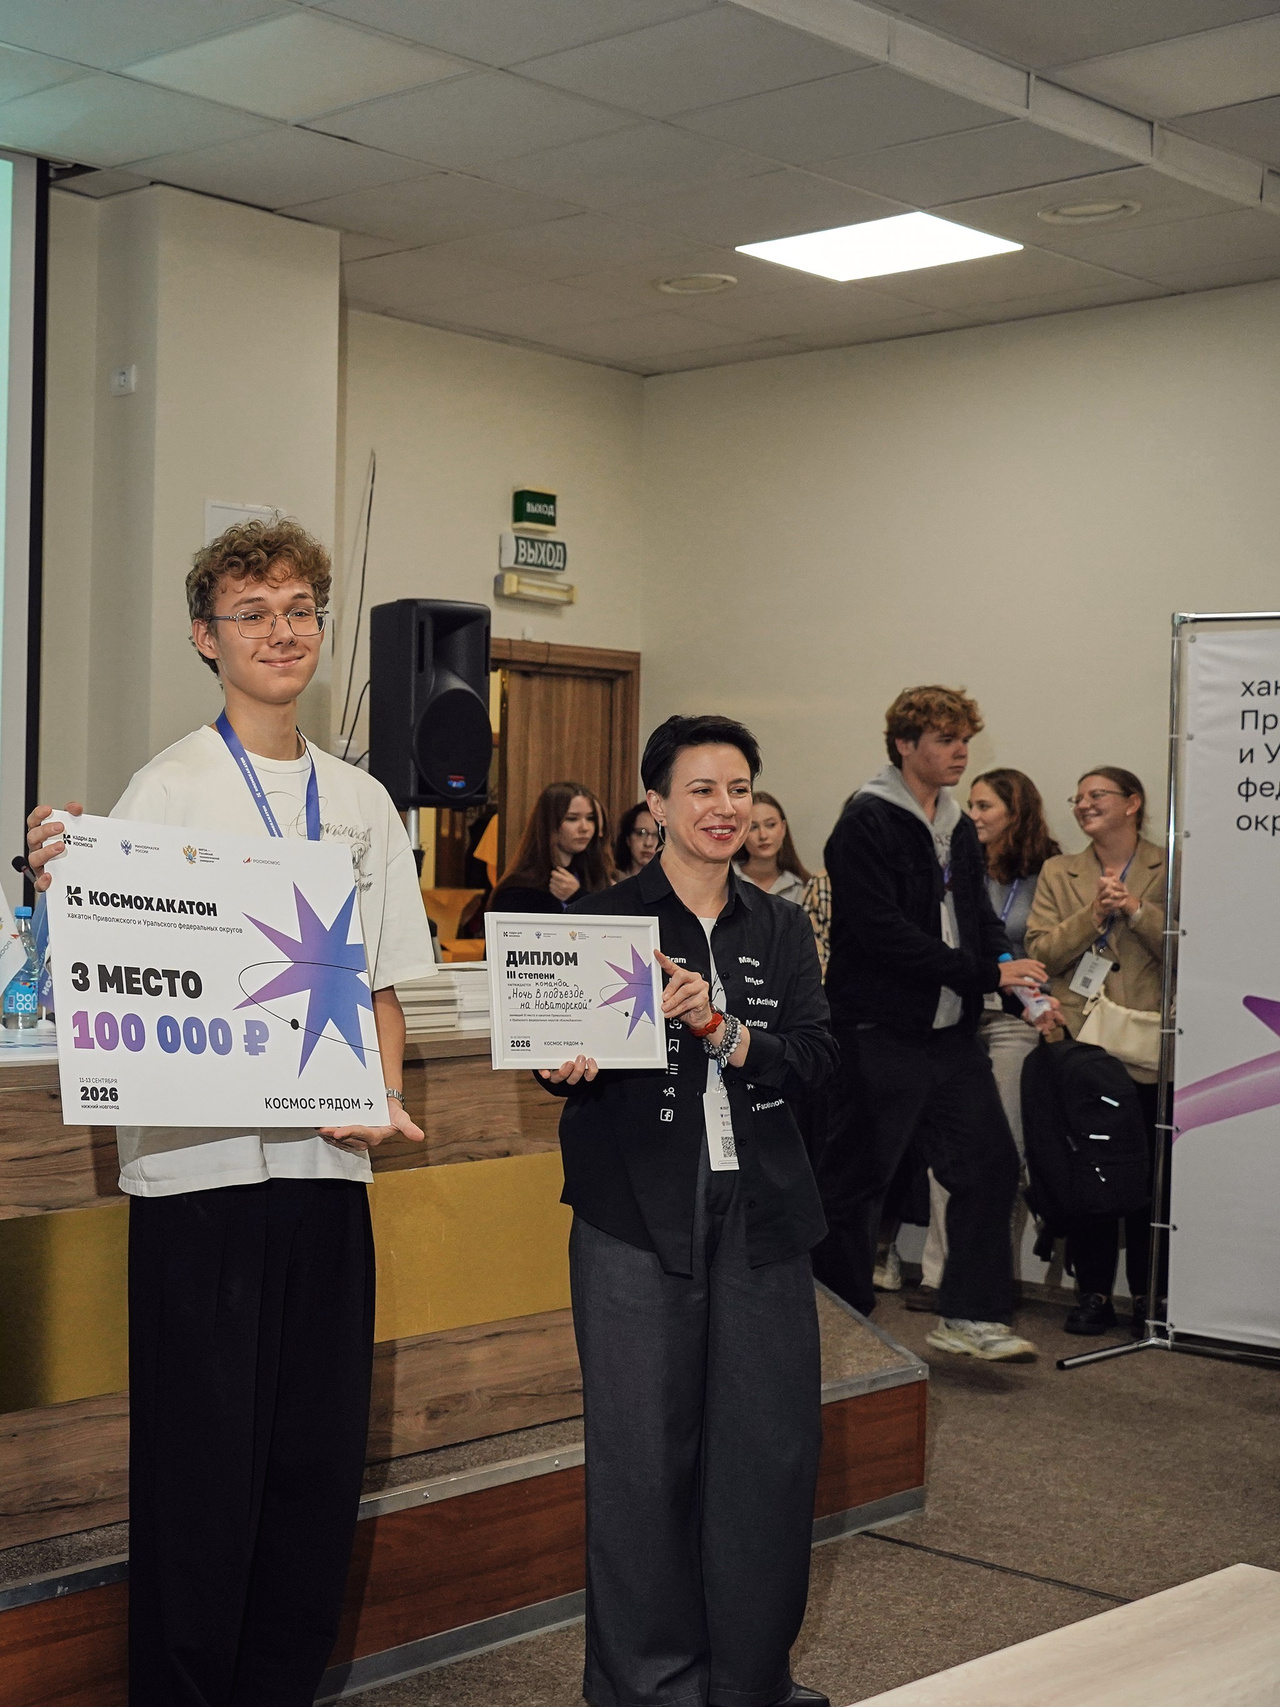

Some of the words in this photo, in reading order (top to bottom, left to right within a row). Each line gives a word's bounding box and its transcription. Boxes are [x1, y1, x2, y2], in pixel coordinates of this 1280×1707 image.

[518, 539, 564, 570] ВЫХОД
[1239, 748, 1255, 764] и
[88, 890, 218, 917] КОСМОХАКАТОН
[67, 912, 92, 921] хакатон
[92, 914, 137, 926] Приволжского
[143, 919, 177, 930] Уральского
[178, 922, 219, 933] федеральных
[219, 926, 243, 935] округов
[506, 951, 579, 968] ДИПЛОМ
[71, 961, 91, 992] 3
[97, 963, 203, 999] МЕСТО
[518, 972, 555, 980] степени
[535, 978, 569, 987] команда
[543, 983, 584, 999] подъезде
[520, 1001, 530, 1009] на
[72, 1010, 147, 1053] 100
[156, 1014, 234, 1056] 000
[510, 1040, 531, 1048] 2026
[80, 1086, 119, 1102] 2026
[264, 1097, 316, 1110] КОСМОС
[319, 1098, 361, 1112] РЯДОМ
